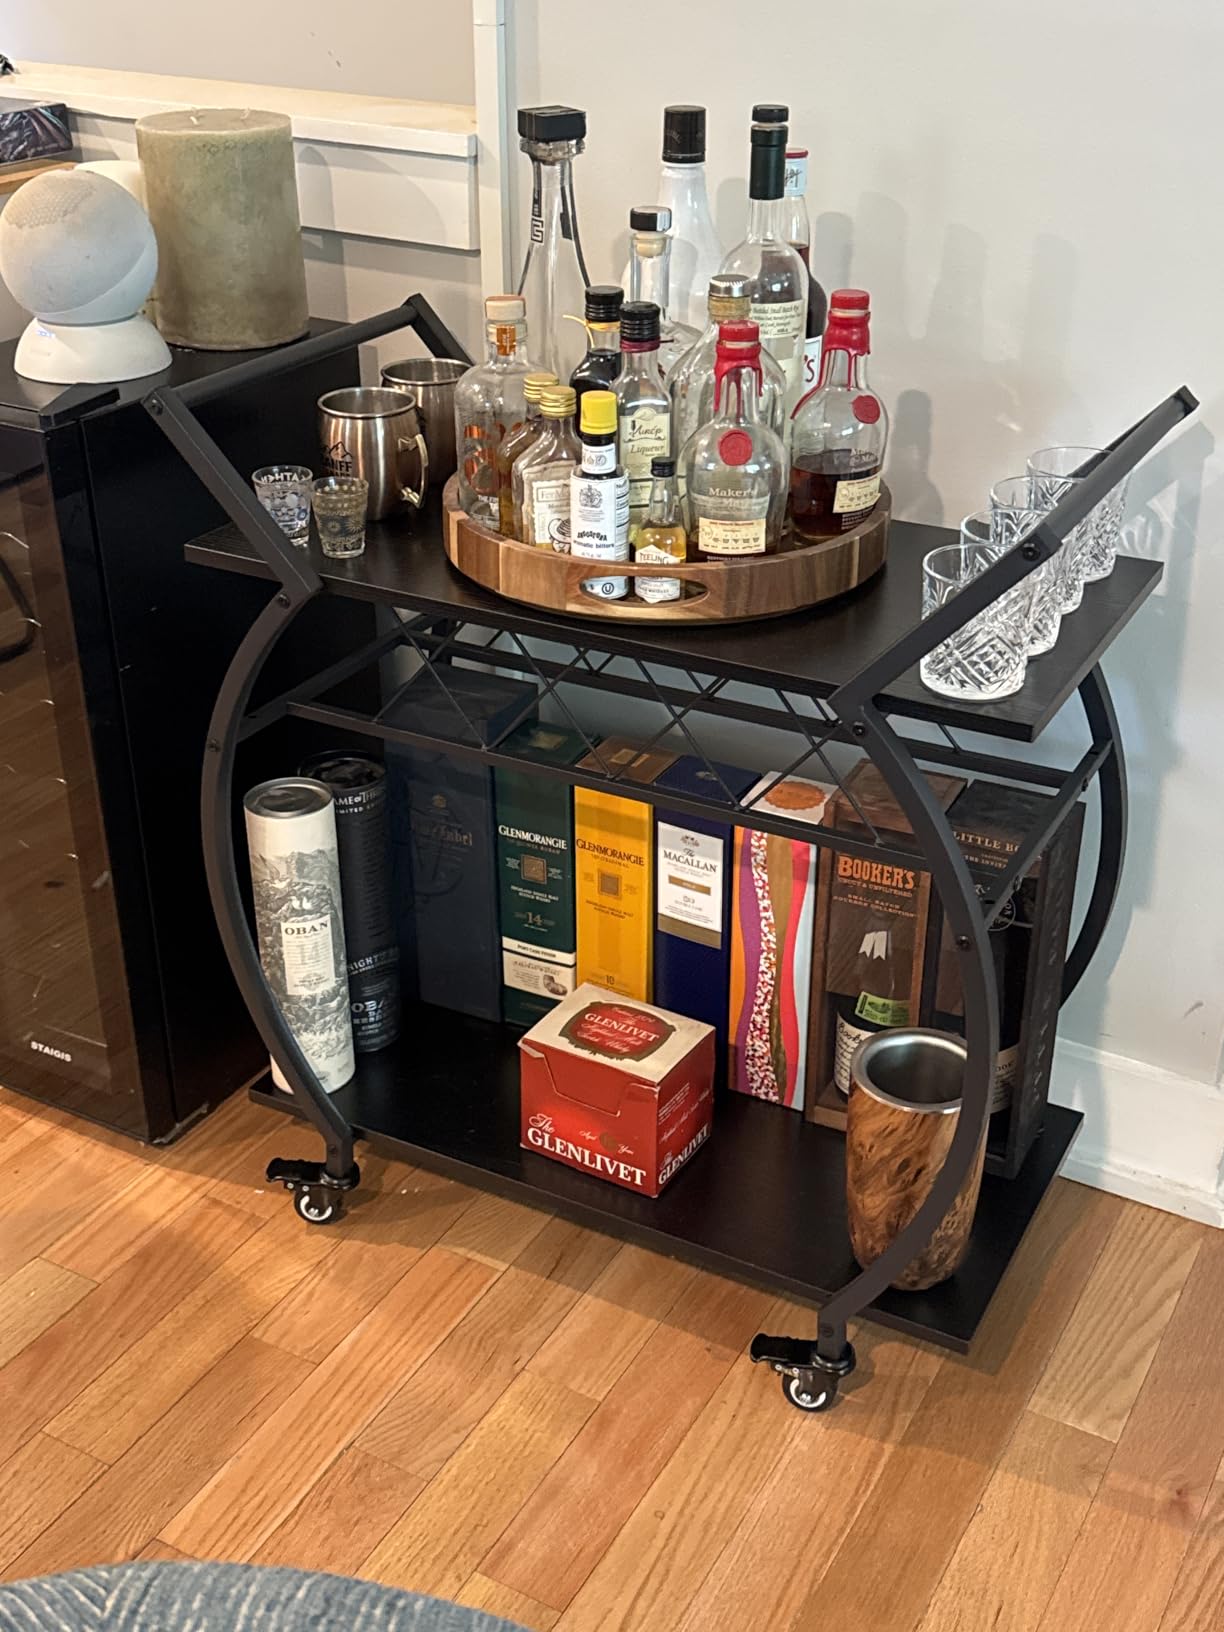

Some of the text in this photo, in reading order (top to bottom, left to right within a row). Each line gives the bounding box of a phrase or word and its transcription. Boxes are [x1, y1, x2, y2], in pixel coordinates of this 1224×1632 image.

[631, 444, 665, 456] Liqueur
[708, 487, 755, 498] Maker's
[498, 825, 568, 850] GLENMORANGIE
[953, 831, 1000, 850] LITTLE
[576, 838, 645, 867] GLENMORANGIE
[663, 850, 718, 873] MACALLAN
[683, 848, 696, 858] The
[838, 855, 916, 890] BOOKER'S
[868, 884, 913, 898] UNFILTERED
[847, 894, 901, 909] SMALL BATCH
[284, 920, 328, 936] OBAN
[527, 912, 542, 926] 14
[606, 975, 615, 985] 10
[584, 1013, 660, 1042] GLENLIVET
[30, 1041, 73, 1063] STAIGIS
[528, 1113, 554, 1134] The
[527, 1127, 647, 1186] GLENLIVET
[658, 1122, 709, 1186] GLENLIVET
